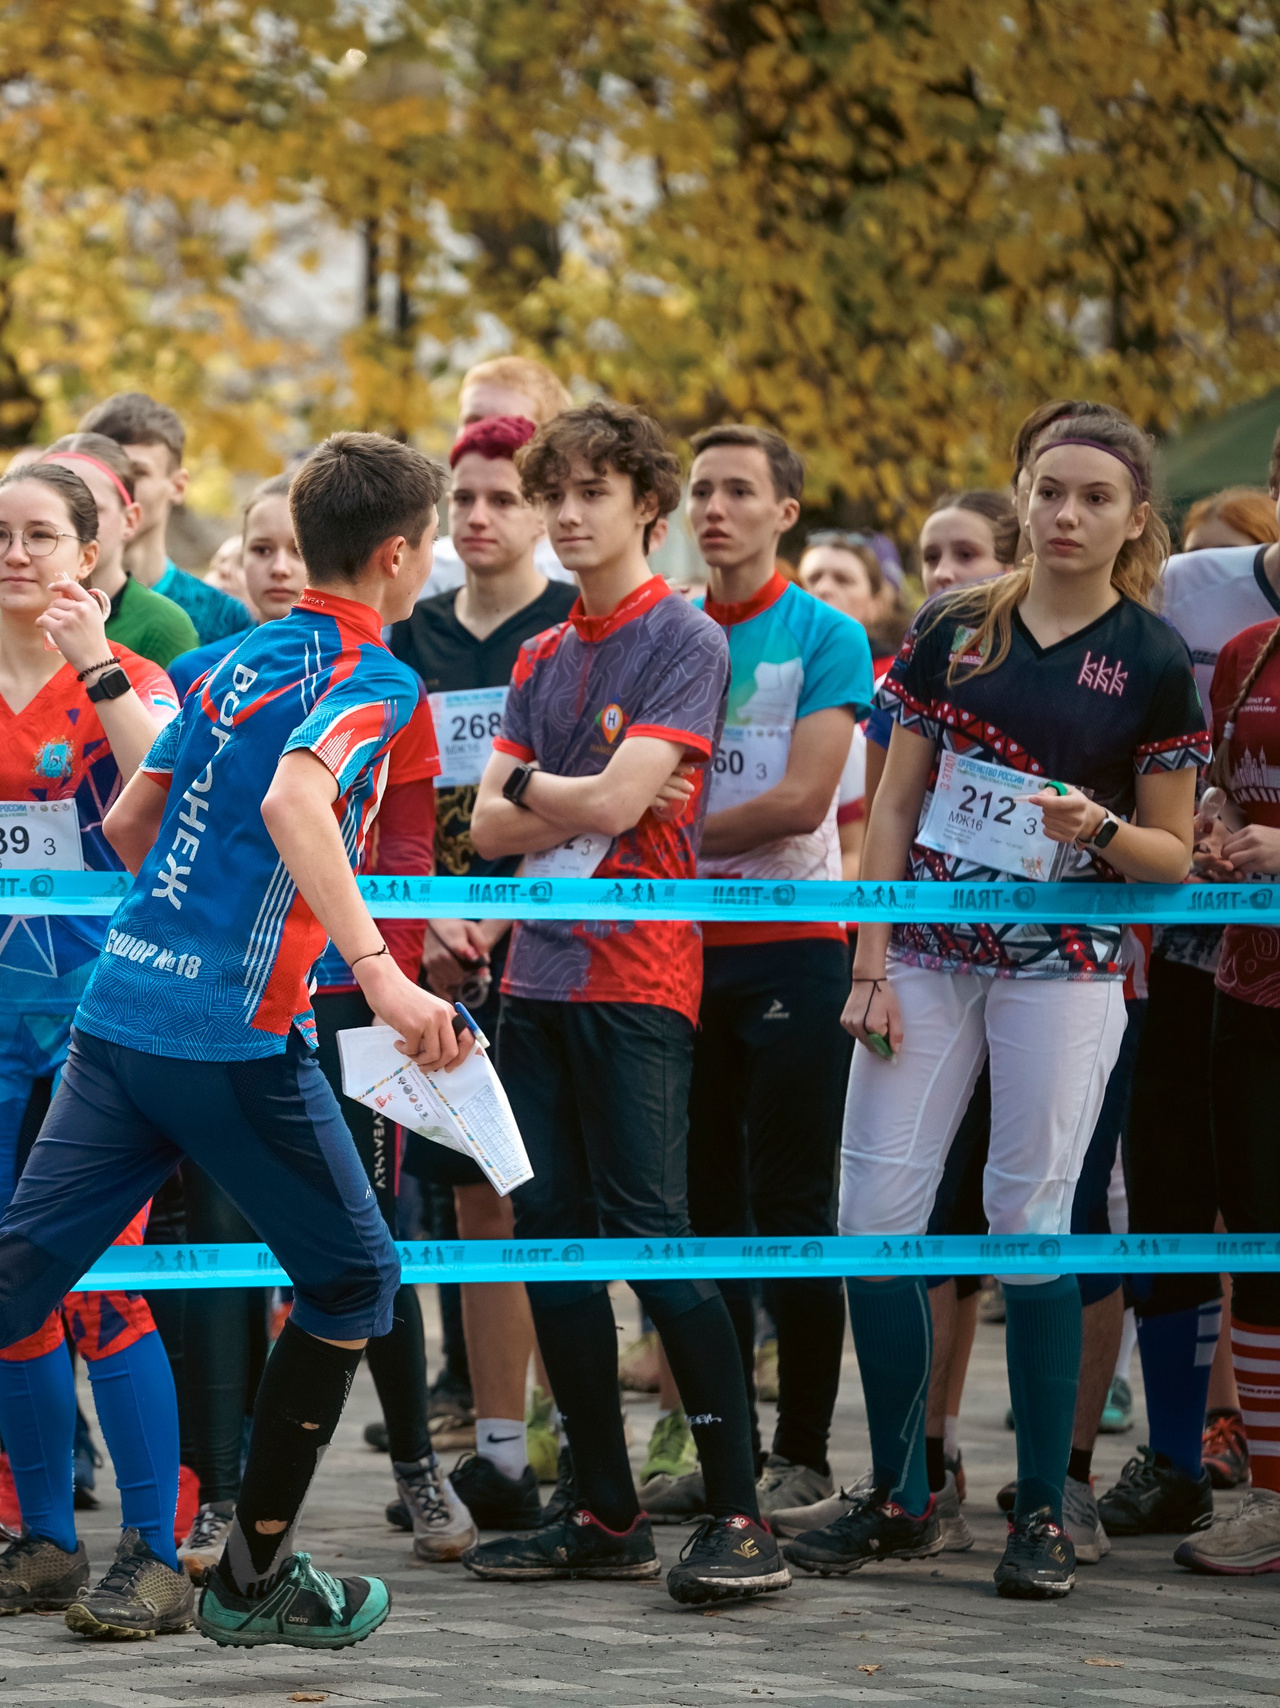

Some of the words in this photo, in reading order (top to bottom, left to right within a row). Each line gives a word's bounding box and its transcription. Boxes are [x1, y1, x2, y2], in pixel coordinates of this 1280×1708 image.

[451, 711, 502, 742] 268
[756, 761, 768, 780] 3
[942, 754, 956, 781] ЭТАП
[997, 769, 1025, 786] РОССИИ
[151, 663, 258, 911] ВОРОНЕЖ
[0, 803, 27, 814] РОССИИ
[958, 784, 1017, 826] 212
[1023, 817, 1038, 836] 3
[948, 810, 984, 832] МЖ16
[43, 837, 57, 856] 3
[581, 838, 593, 856] 3
[105, 928, 159, 964] СШОР
